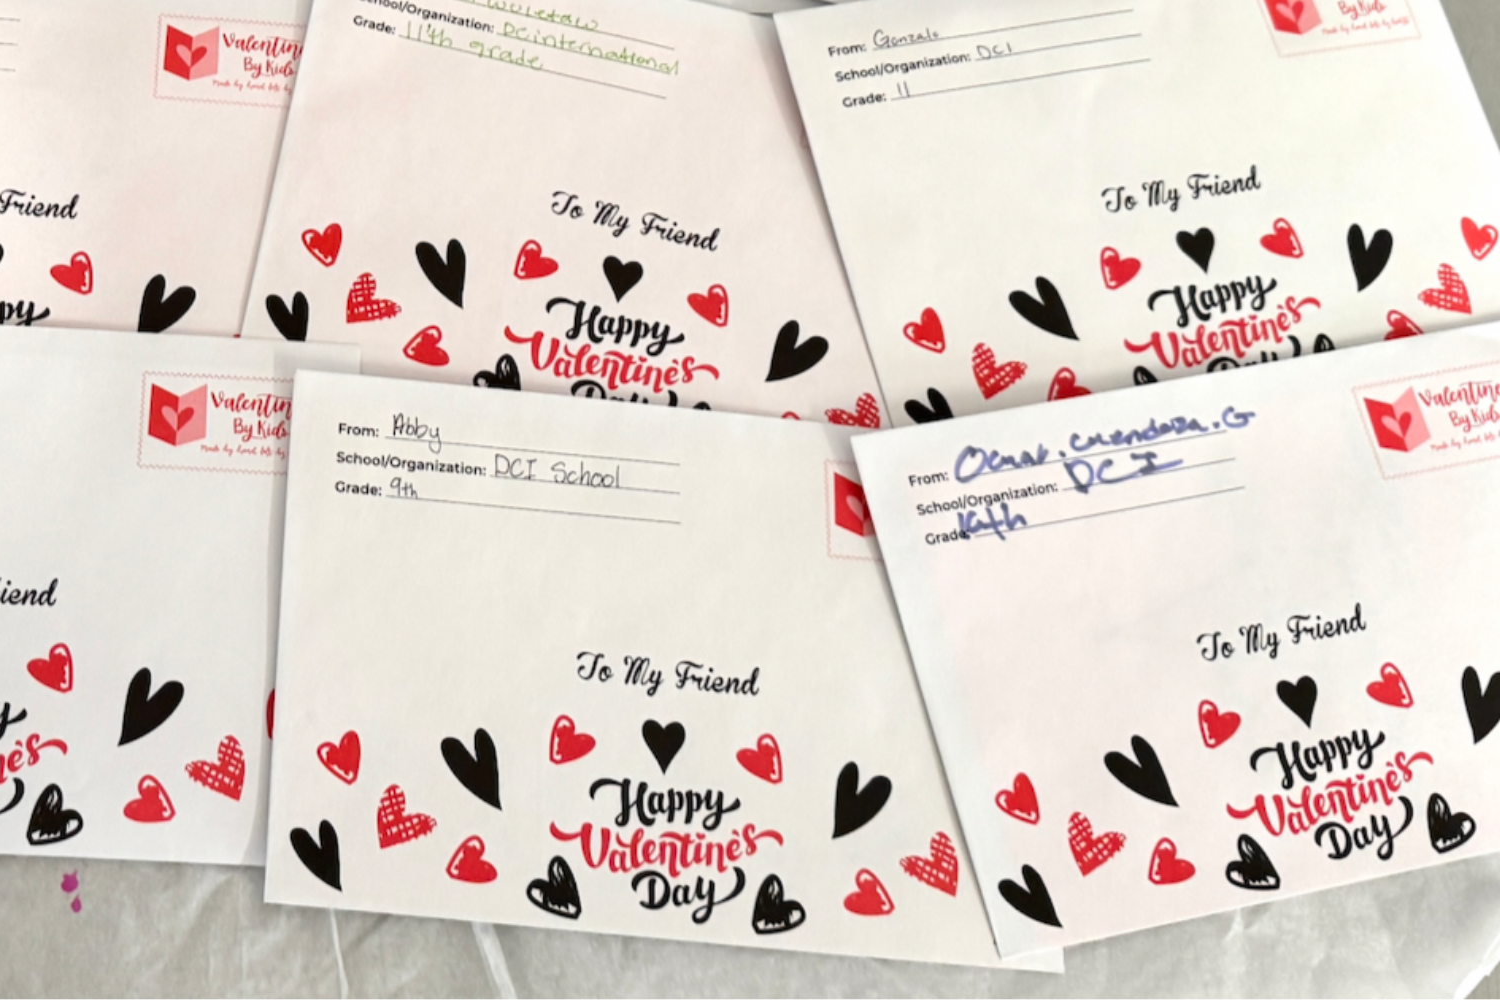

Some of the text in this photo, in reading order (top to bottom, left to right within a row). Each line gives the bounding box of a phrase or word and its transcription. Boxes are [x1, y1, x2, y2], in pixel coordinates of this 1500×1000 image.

[353, 14, 396, 36] Grade:
[827, 43, 867, 58] From:
[834, 51, 972, 83] School/Organization:
[842, 91, 887, 108] Grade:
[1101, 164, 1262, 214] To My Friend
[551, 190, 720, 252] To My Friend
[546, 296, 685, 356] Happy
[1148, 274, 1277, 328] Happy
[504, 325, 720, 392] Valentine's
[1123, 295, 1321, 370] Valentine's
[337, 413, 443, 453] From: Abby
[334, 476, 419, 499] Grade: 9th
[336, 451, 487, 478] School/Organization:
[551, 461, 622, 490] School
[908, 470, 949, 488] From:
[916, 482, 1058, 517] School/Organization:
[1196, 602, 1367, 662] To My Friend
[576, 651, 760, 696] To My Friend
[1249, 726, 1386, 790] Happy
[589, 777, 741, 831] Happy
[1225, 750, 1434, 838] Valentine's
[549, 822, 784, 878] Valentine's
[1314, 795, 1414, 861] Day
[631, 867, 747, 925] Day
